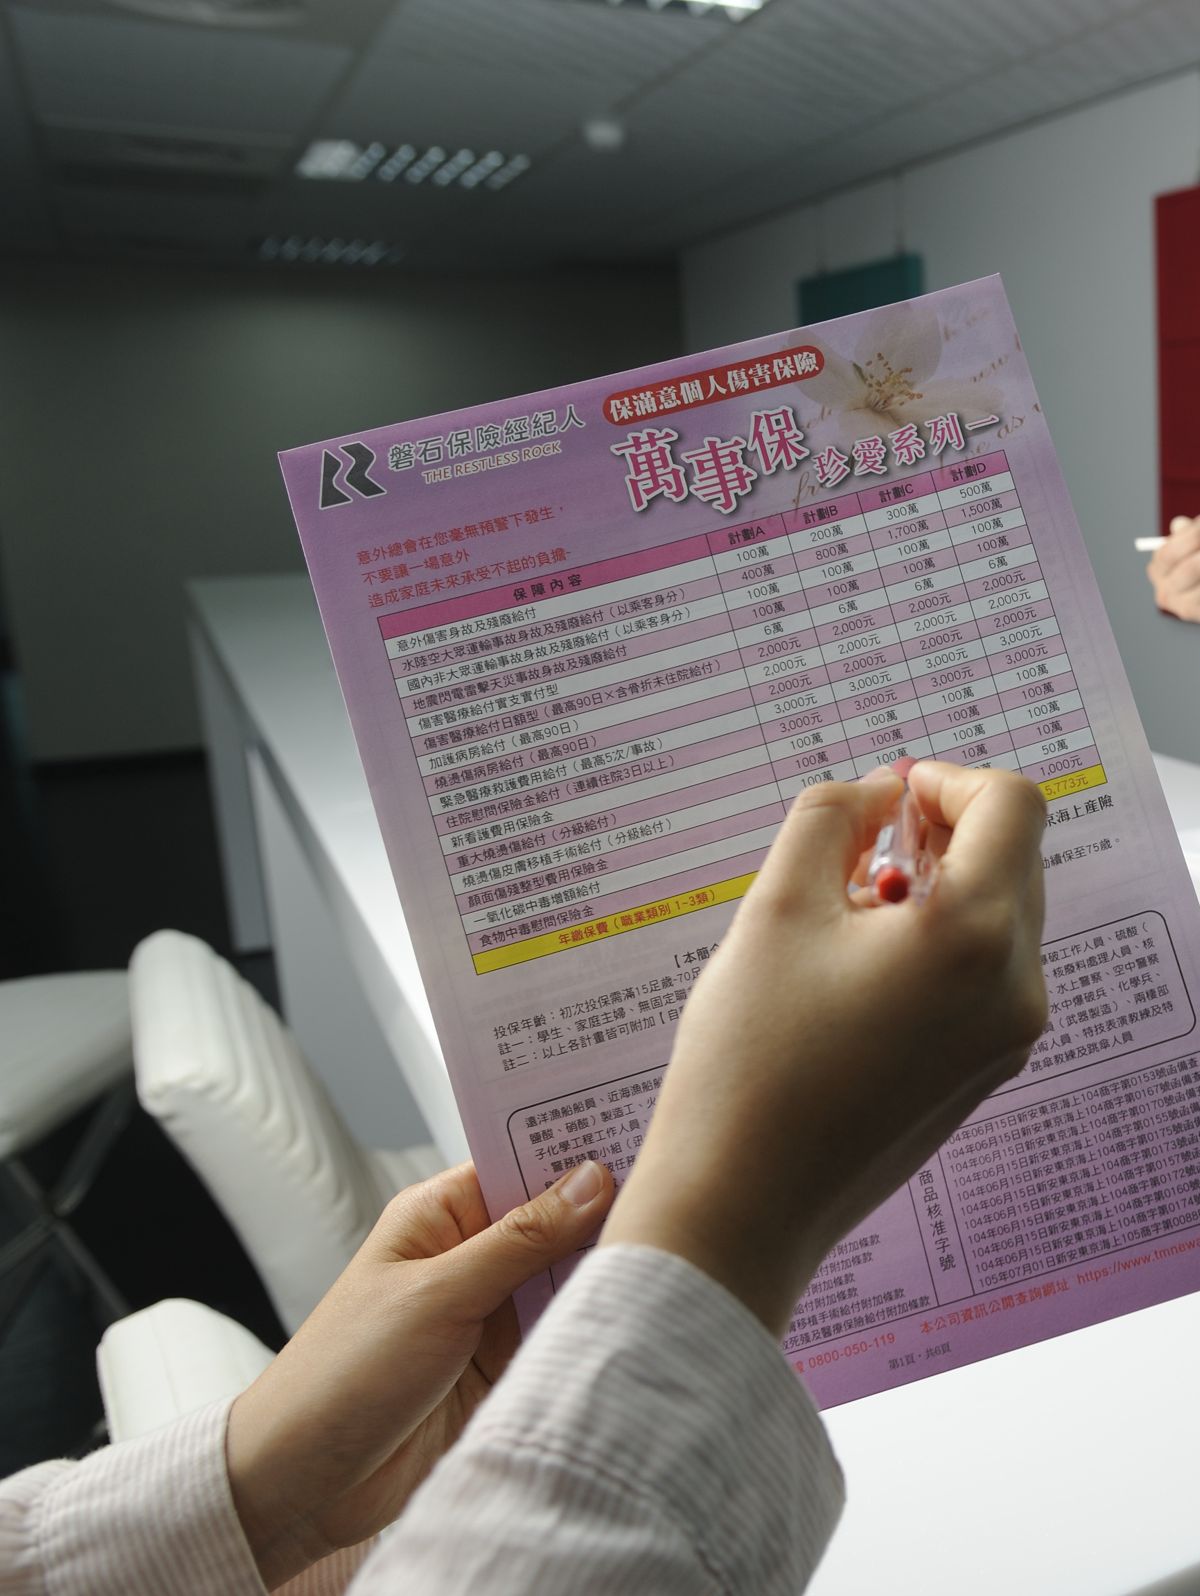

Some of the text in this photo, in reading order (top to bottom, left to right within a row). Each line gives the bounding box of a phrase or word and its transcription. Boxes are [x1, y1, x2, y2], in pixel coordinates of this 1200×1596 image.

[608, 349, 819, 422] 保滿意個人傷害保險
[387, 401, 584, 473] 磐石保險經紀人
[423, 440, 561, 483] THE RESTLESS ROCK
[610, 404, 811, 517] 萬事保
[811, 412, 999, 489] 珍愛系列一
[362, 548, 470, 586] 不要讓一場意外
[396, 482, 992, 652] 意外傷害身故及殘廢給付 100萬 200萬 300萬 500萬
[512, 462, 987, 602] 保障內容 計劃A 計劃B 計劃C 計劃D
[741, 564, 774, 581] 400萬
[815, 543, 848, 560] 800萬
[886, 520, 928, 539] 1,700萬
[960, 499, 1002, 517] 1,500萬
[746, 582, 779, 599] 100萬
[821, 561, 854, 578] 100萬
[897, 539, 929, 556] 100萬
[970, 518, 1003, 534] 100萬
[752, 601, 785, 618] 100萬
[826, 580, 859, 597] 100萬
[902, 558, 935, 574] 100萬
[976, 536, 1009, 553] 100萬
[757, 638, 800, 657] 2,000元
[832, 615, 875, 635] 2,000元
[909, 593, 950, 612] 2,000元
[983, 572, 1024, 591] 2,000元
[418, 556, 1008, 730] 傷害醫療給付實支實付型 6萬 6萬 6萬 6萬
[429, 590, 1030, 769] 加護病房給付（最高90日） 2,000元 2,000元 2,000元 2,000元
[774, 694, 817, 713] 3,000元
[849, 672, 891, 691] 3,000元
[925, 649, 967, 668] 3,000元
[1000, 626, 1041, 646] 3,000元
[434, 608, 1036, 789] 燒燙傷病房給付（最高90日） 2,000元 2,000元 2,000元 2,000元
[780, 712, 822, 732] 3,000元
[854, 690, 897, 710] 3,000元
[931, 668, 973, 687] 3,000元
[1005, 645, 1047, 664] 3,000元
[952, 724, 985, 741] 100萬
[1027, 701, 1060, 718] 100萬
[451, 664, 1048, 847] 新看護費用保險金 100萬 100萬 100萬 100萬
[456, 683, 1054, 867] 重大燒燙傷給付（分級給付） 100萬 100萬 100萬 100萬
[1046, 774, 1087, 794] 5,773元
[467, 721, 1062, 907] 顏面傷殘整型費用保險金 10萬 10萬
[473, 739, 1068, 927] 一氧化碳中毒增額給付 50萬
[479, 756, 1082, 946] 食物中毒慰問保險金 1,000元
[498, 987, 693, 1055] 註一：學生、家庭主婦、無固定職
[917, 1169, 956, 1271] 商品核准字號
[808, 1332, 895, 1368] 0800-050-119
[919, 1278, 1068, 1335] 本公司資訊公開查詢網址
